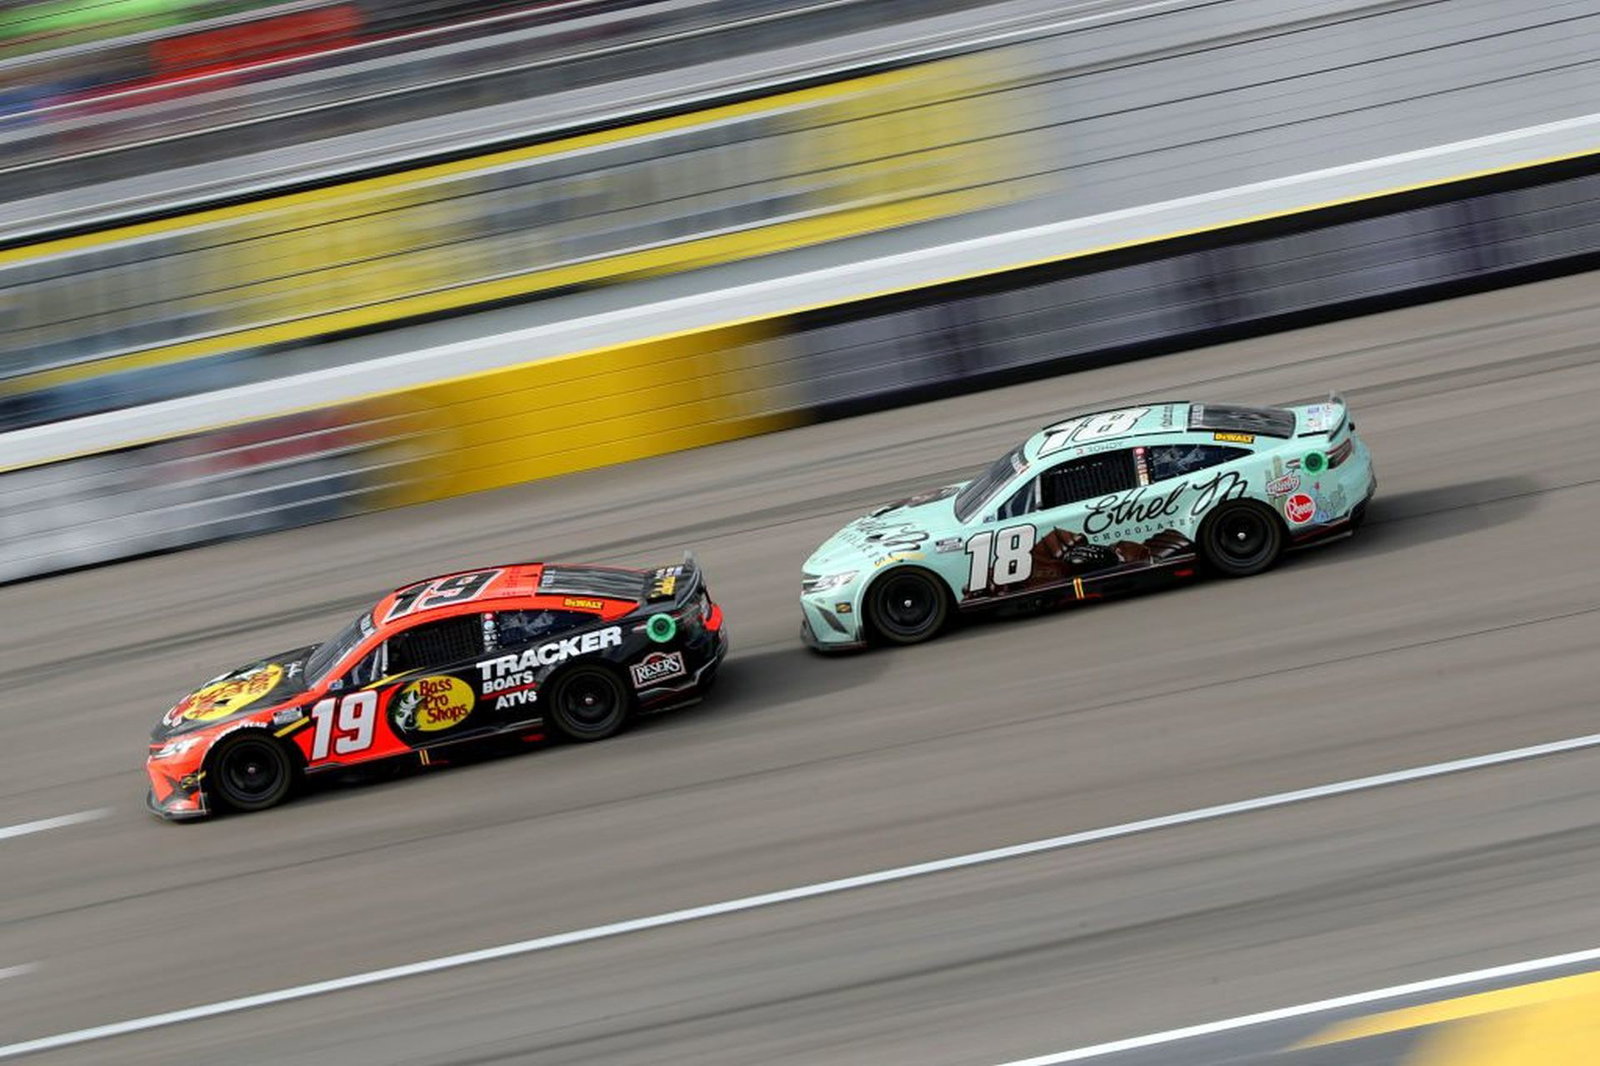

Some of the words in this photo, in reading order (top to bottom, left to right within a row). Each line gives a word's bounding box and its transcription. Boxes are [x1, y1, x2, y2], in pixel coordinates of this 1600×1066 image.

[1083, 480, 1188, 535] Ethel
[1092, 516, 1195, 543] CHOCOLATES
[964, 522, 1037, 592] 18
[381, 568, 506, 624] 19
[476, 624, 622, 681] TRACKER
[419, 678, 453, 696] Bass
[482, 670, 535, 695] BOATS
[424, 693, 449, 711] Pro
[426, 703, 469, 724] Shops
[495, 690, 538, 711] ATVs
[311, 689, 379, 761] 19
